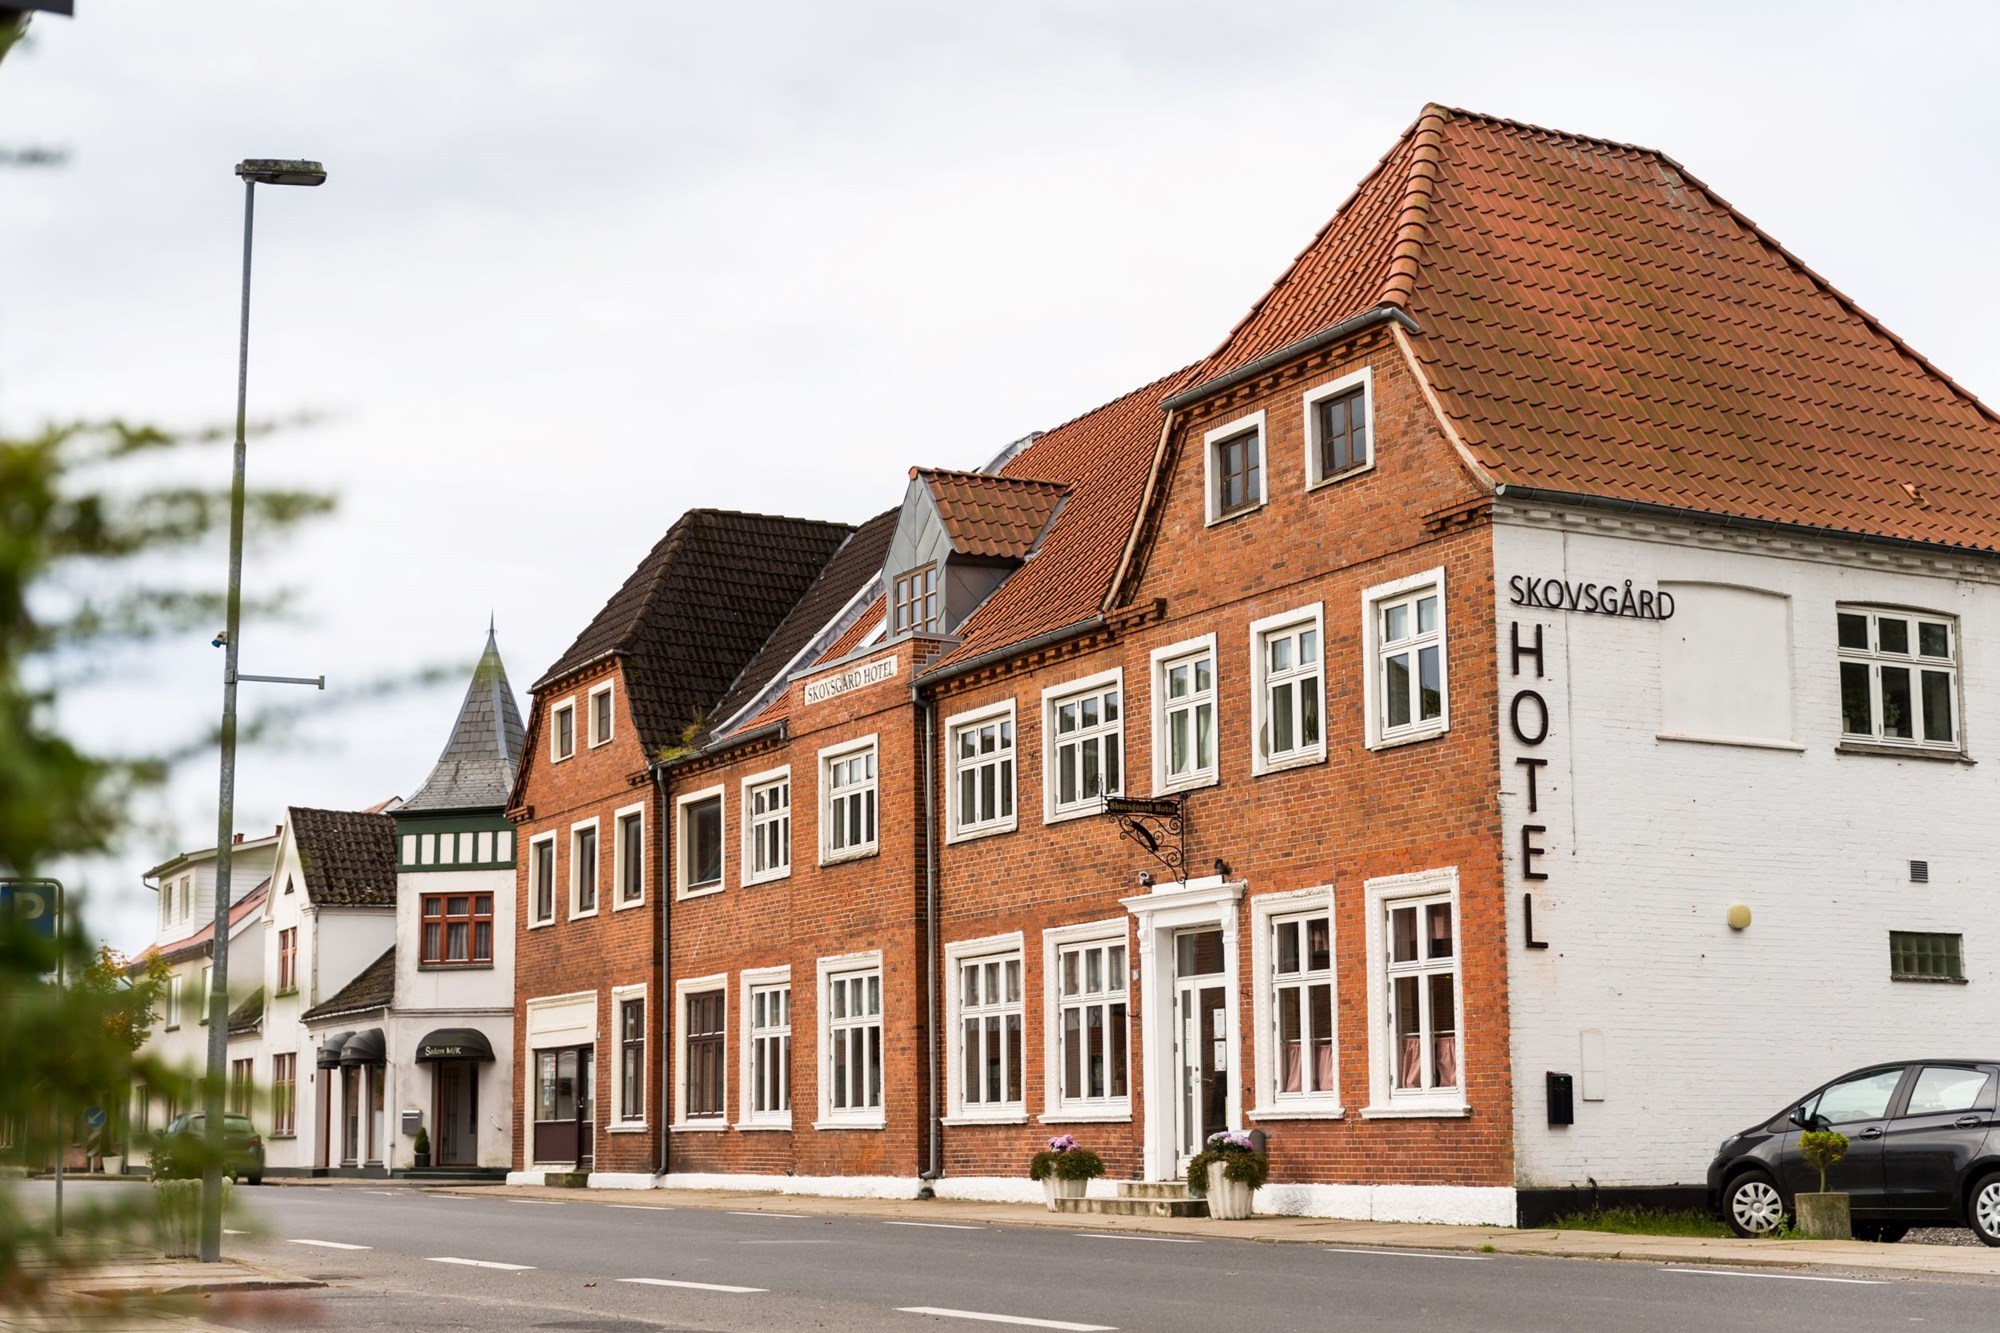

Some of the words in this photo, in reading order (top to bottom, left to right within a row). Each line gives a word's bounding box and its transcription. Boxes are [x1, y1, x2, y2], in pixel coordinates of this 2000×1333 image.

[1510, 574, 1675, 620] SKOVSGÅRD
[863, 660, 893, 685] HOTEL
[1511, 621, 1549, 949] HOTEL
[1110, 801, 1152, 812] Skovsgaard
[1155, 804, 1175, 813] Hotel
[14, 892, 45, 926] P
